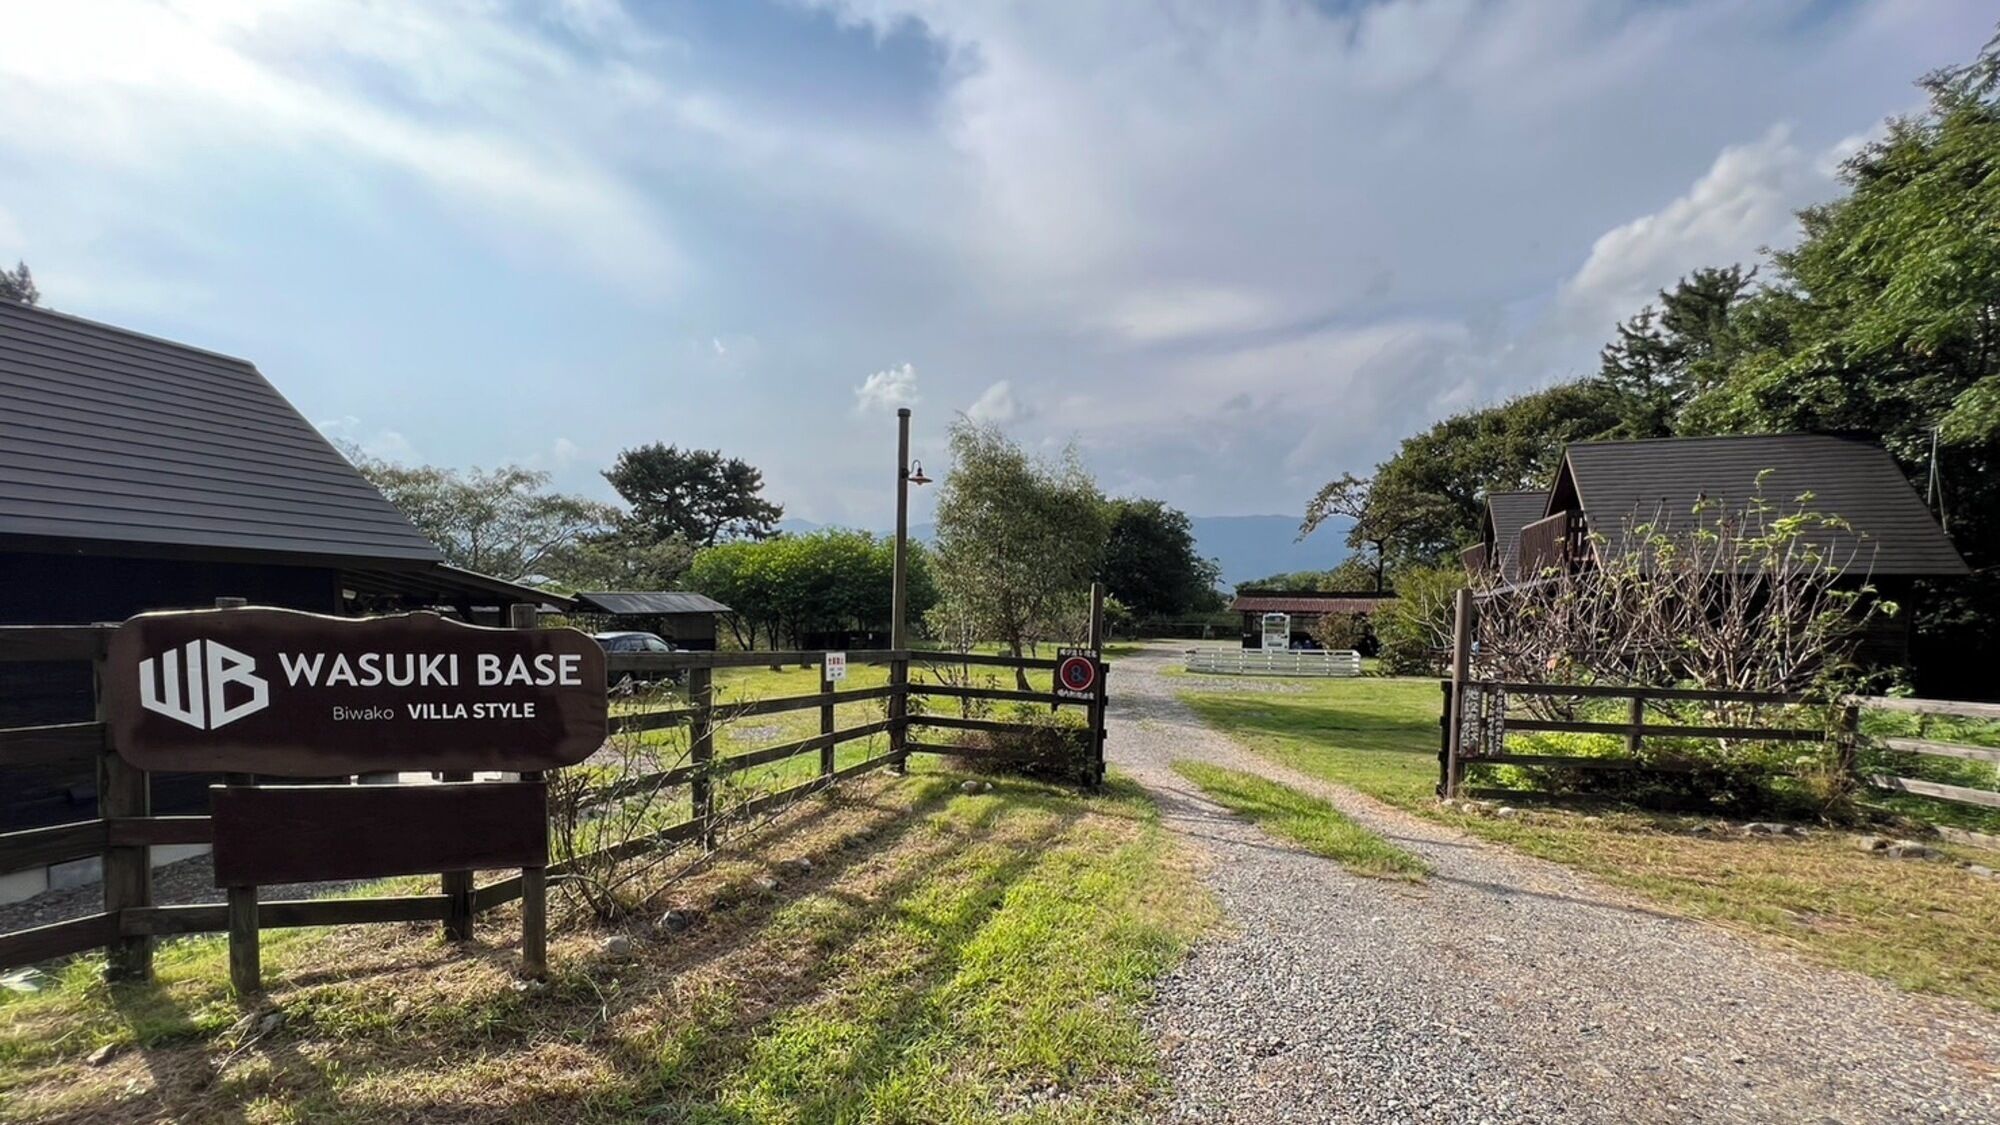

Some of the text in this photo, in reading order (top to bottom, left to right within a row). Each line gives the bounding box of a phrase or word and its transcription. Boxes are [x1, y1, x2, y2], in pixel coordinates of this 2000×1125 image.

[279, 653, 581, 686] WASUKI BASE
[334, 703, 535, 720] Biwako VILLA STYLE
